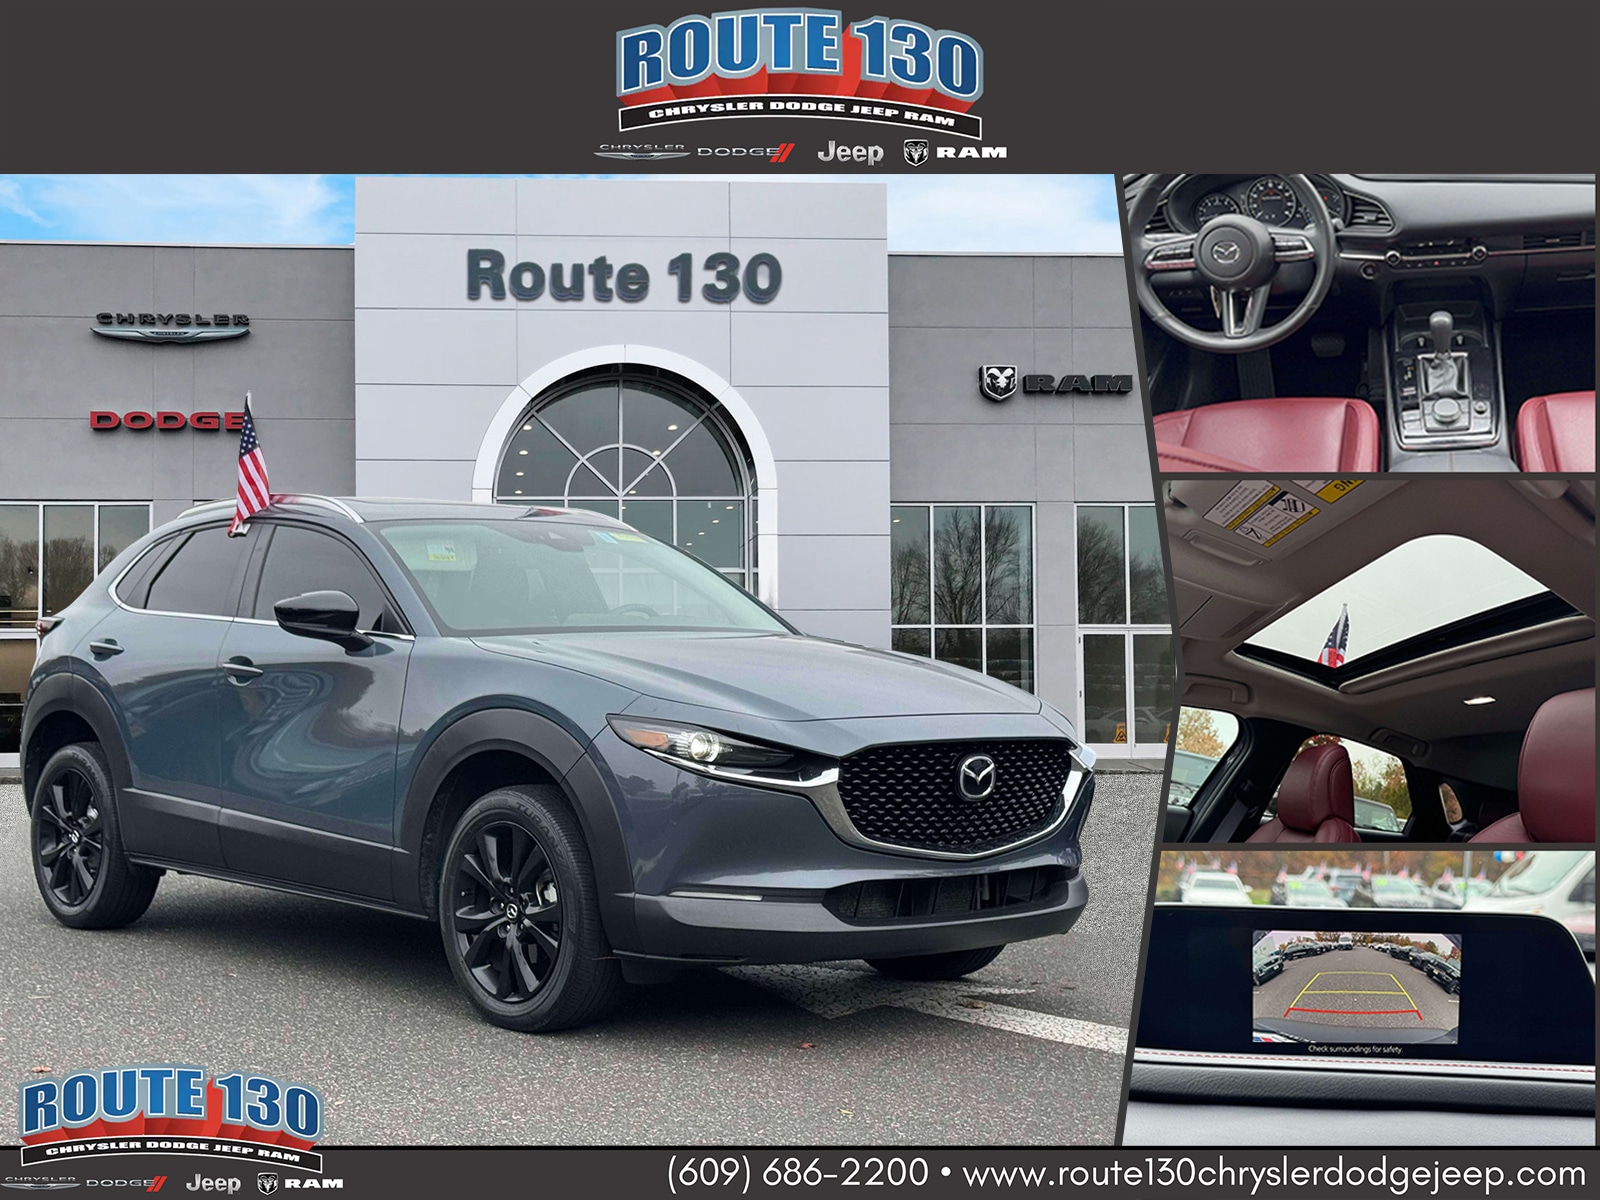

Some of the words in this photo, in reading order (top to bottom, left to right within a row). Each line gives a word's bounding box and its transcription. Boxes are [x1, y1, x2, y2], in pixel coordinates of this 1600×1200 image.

[466, 248, 650, 302] Route
[667, 251, 783, 305] 130
[95, 312, 251, 326] CHRYSLER
[1022, 374, 1134, 394] RAM
[89, 410, 245, 431] DODGE
[1307, 1044, 1328, 1053] Check
[1329, 1045, 1371, 1054] surroundings
[1372, 1045, 1382, 1053] for
